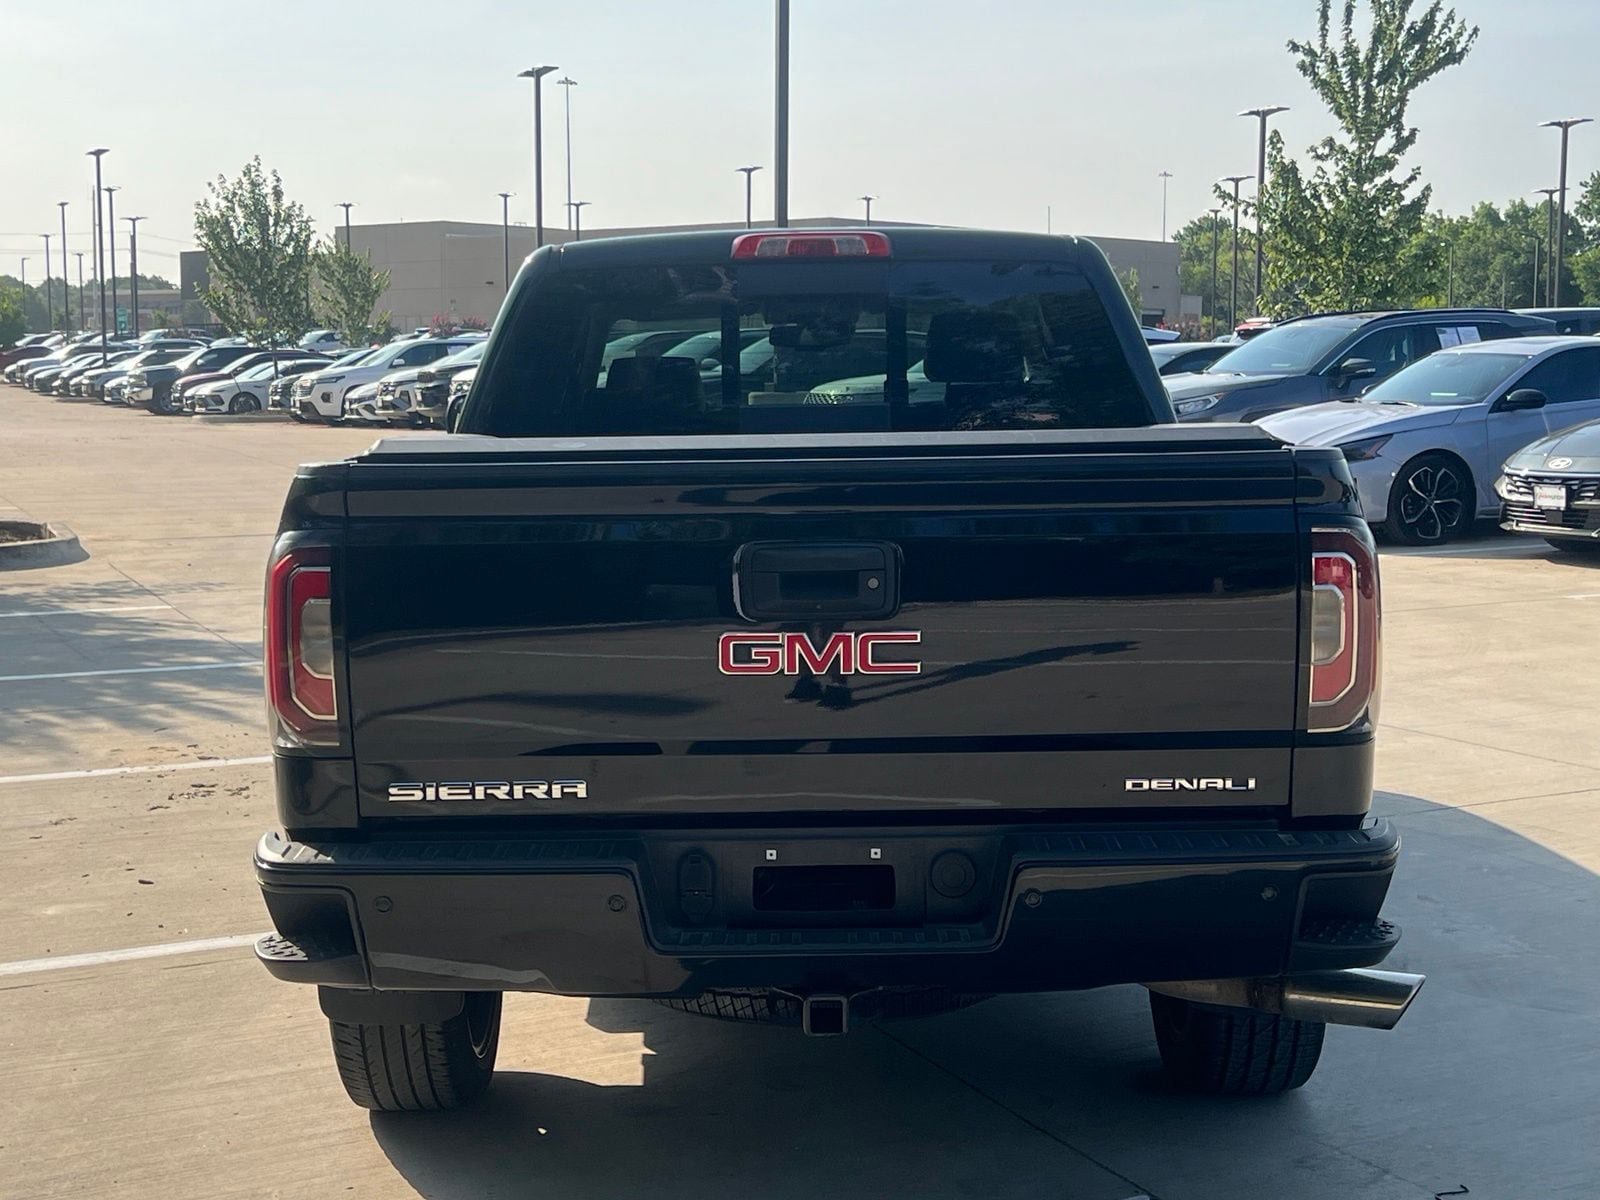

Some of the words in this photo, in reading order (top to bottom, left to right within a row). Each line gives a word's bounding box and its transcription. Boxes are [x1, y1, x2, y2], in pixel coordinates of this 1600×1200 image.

[718, 631, 922, 675] GMC
[387, 779, 588, 801] SIERRA
[1124, 777, 1256, 791] DENALI
